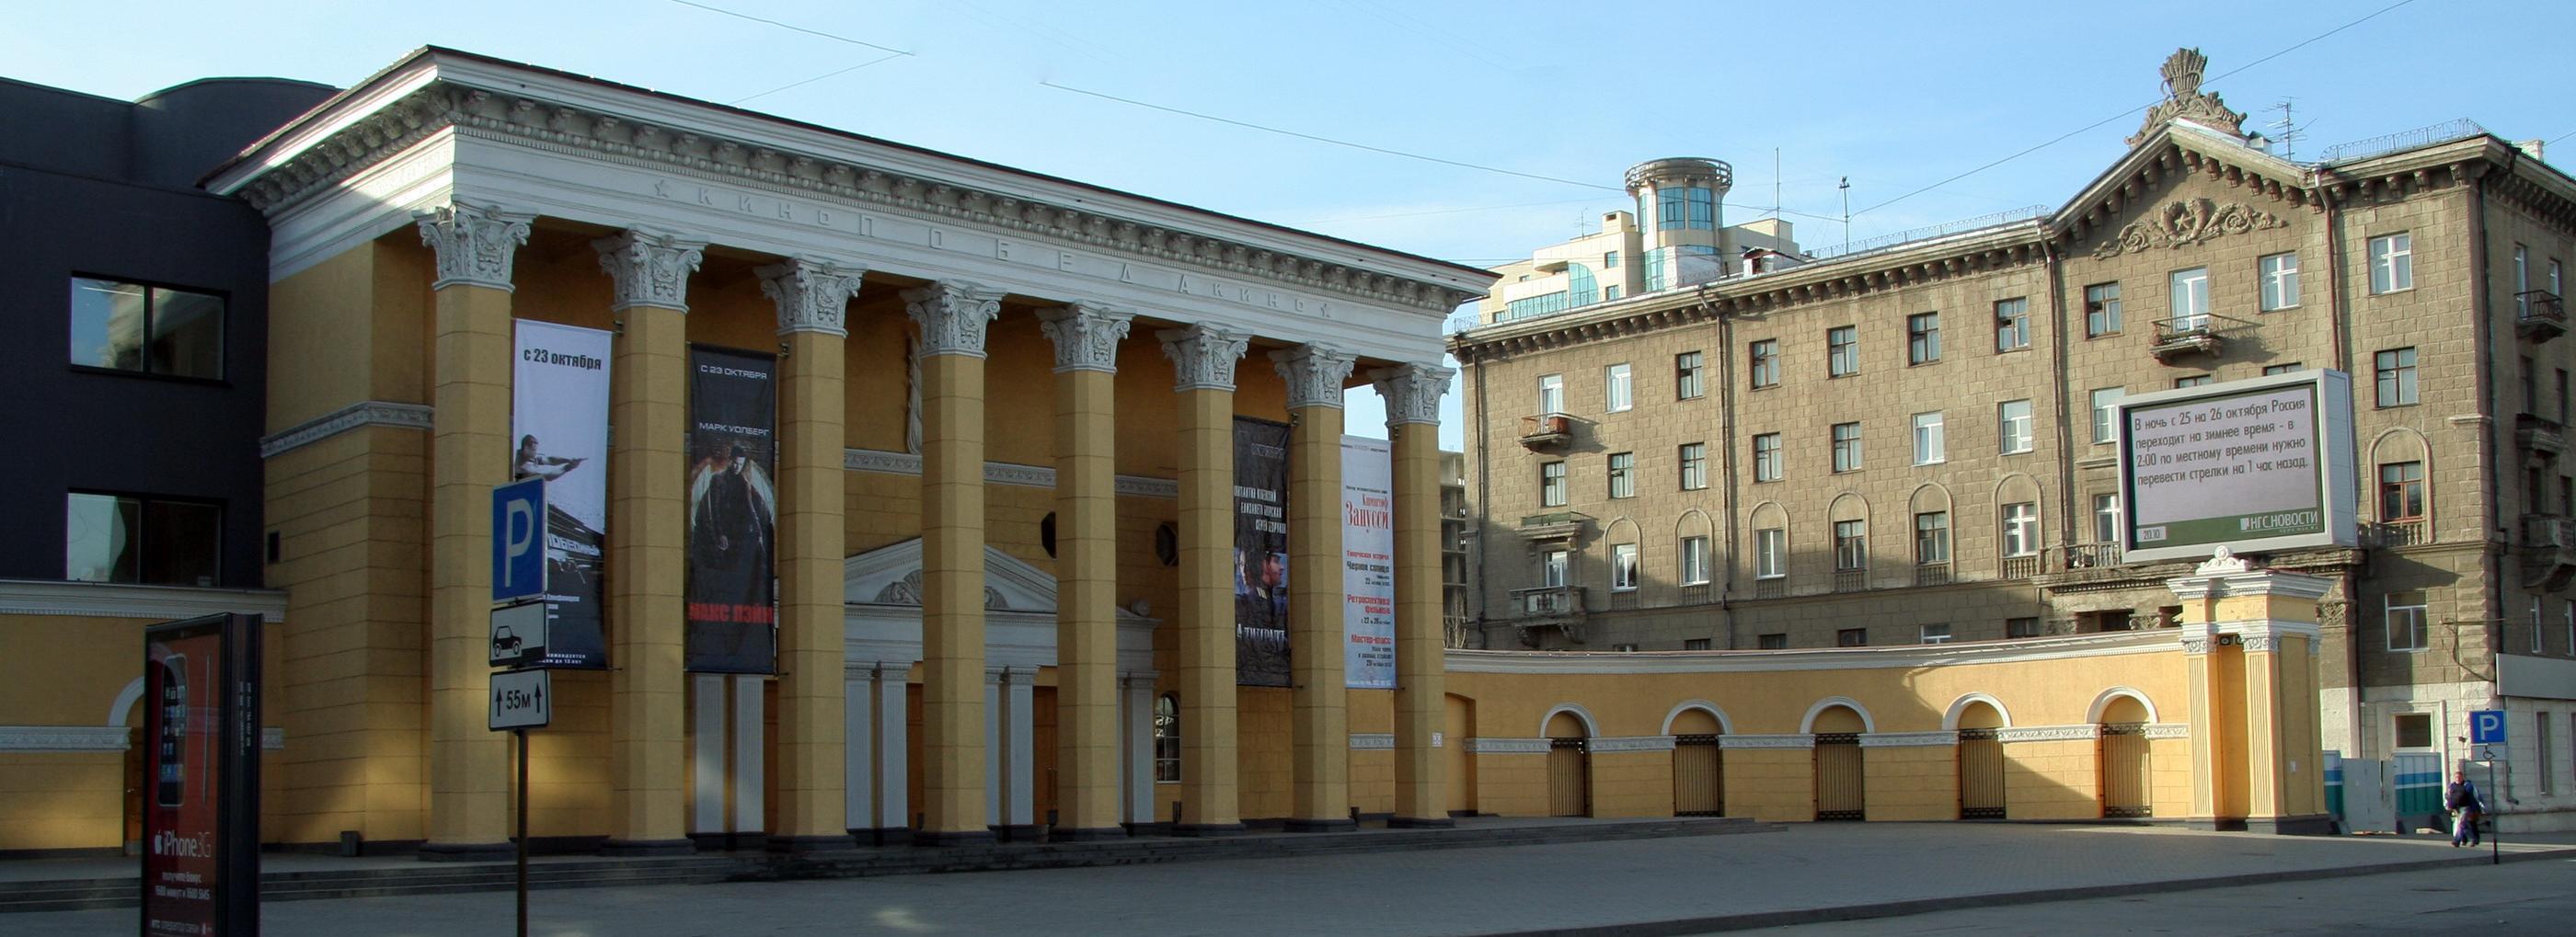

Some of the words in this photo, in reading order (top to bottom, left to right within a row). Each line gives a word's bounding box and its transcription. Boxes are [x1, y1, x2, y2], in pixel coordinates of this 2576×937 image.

[534, 349, 548, 363] 23
[551, 352, 602, 370] октября
[724, 368, 767, 380] ОКТЯБРЯ
[699, 422, 727, 432] МАРК
[729, 426, 769, 437] УОЛБЕРГ
[2134, 417, 2142, 431] В
[2145, 418, 2168, 430] ночь
[2171, 417, 2176, 426] с
[2179, 411, 2191, 426] 25
[2194, 413, 2206, 423] на
[2210, 407, 2222, 421] 26
[2225, 403, 2268, 419] октября
[2271, 399, 2306, 413] Россия
[2135, 434, 2185, 452] переходит
[2190, 432, 2202, 442] на
[2205, 428, 2239, 441] зимнее
[2244, 423, 2275, 439] время
[2137, 452, 2156, 467] 2:00
[2160, 454, 2171, 464] по
[2176, 448, 2222, 463] местному
[2225, 441, 2268, 460] времени
[2272, 438, 2306, 453] нужно
[2137, 471, 2185, 488] перевести
[2189, 466, 2228, 483] стрелки
[2233, 464, 2245, 474] на
[2248, 459, 2253, 473] 1
[2256, 461, 2272, 472] час
[2276, 457, 2308, 470] назад.
[1346, 500, 1389, 532] Занусси
